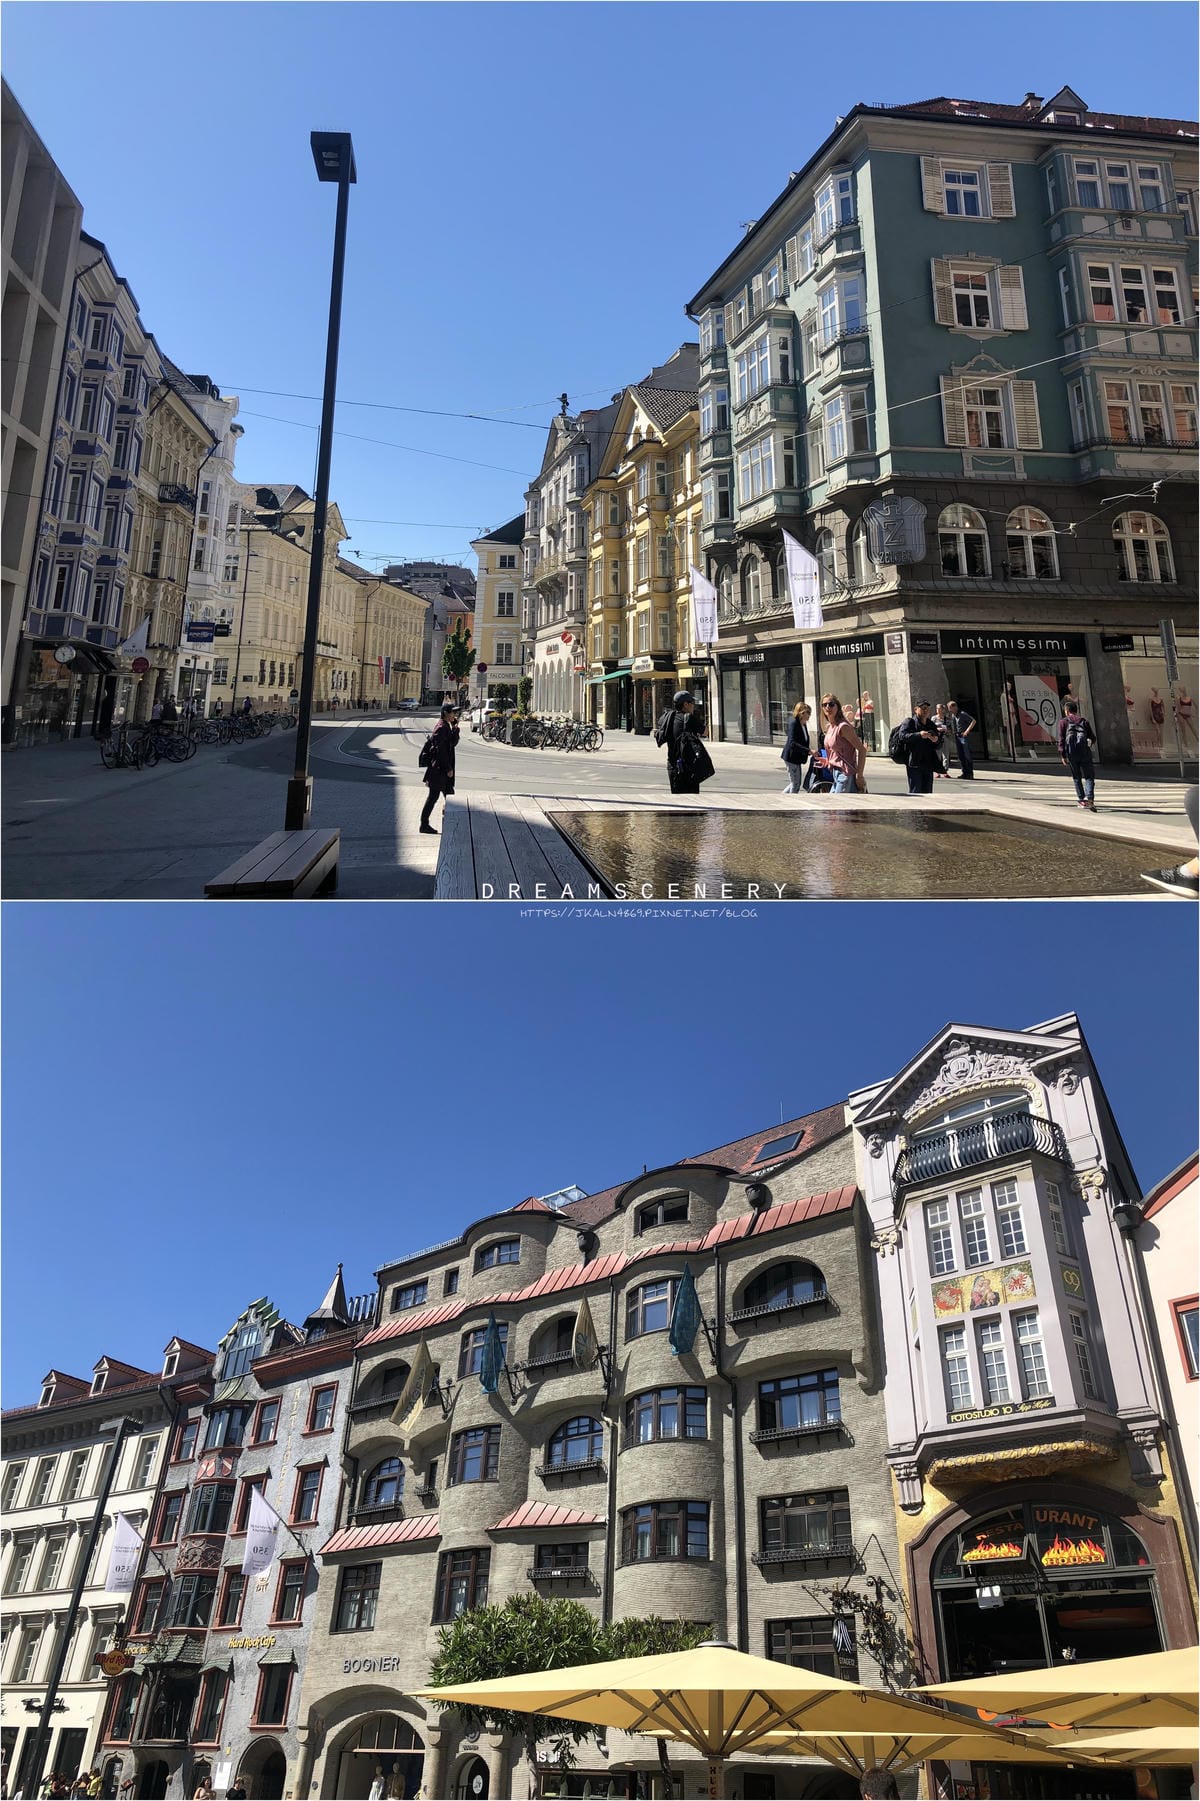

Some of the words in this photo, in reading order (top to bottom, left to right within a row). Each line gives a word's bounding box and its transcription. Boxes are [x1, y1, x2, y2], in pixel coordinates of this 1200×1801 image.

[825, 641, 875, 656] intimissimi
[959, 636, 1067, 650] intimissimi
[950, 1408, 1000, 1423] FOTOSTUDIO
[1001, 1405, 1013, 1415] 10
[1046, 1555, 1101, 1565] HOUSE
[343, 1655, 400, 1674] BOGNER
